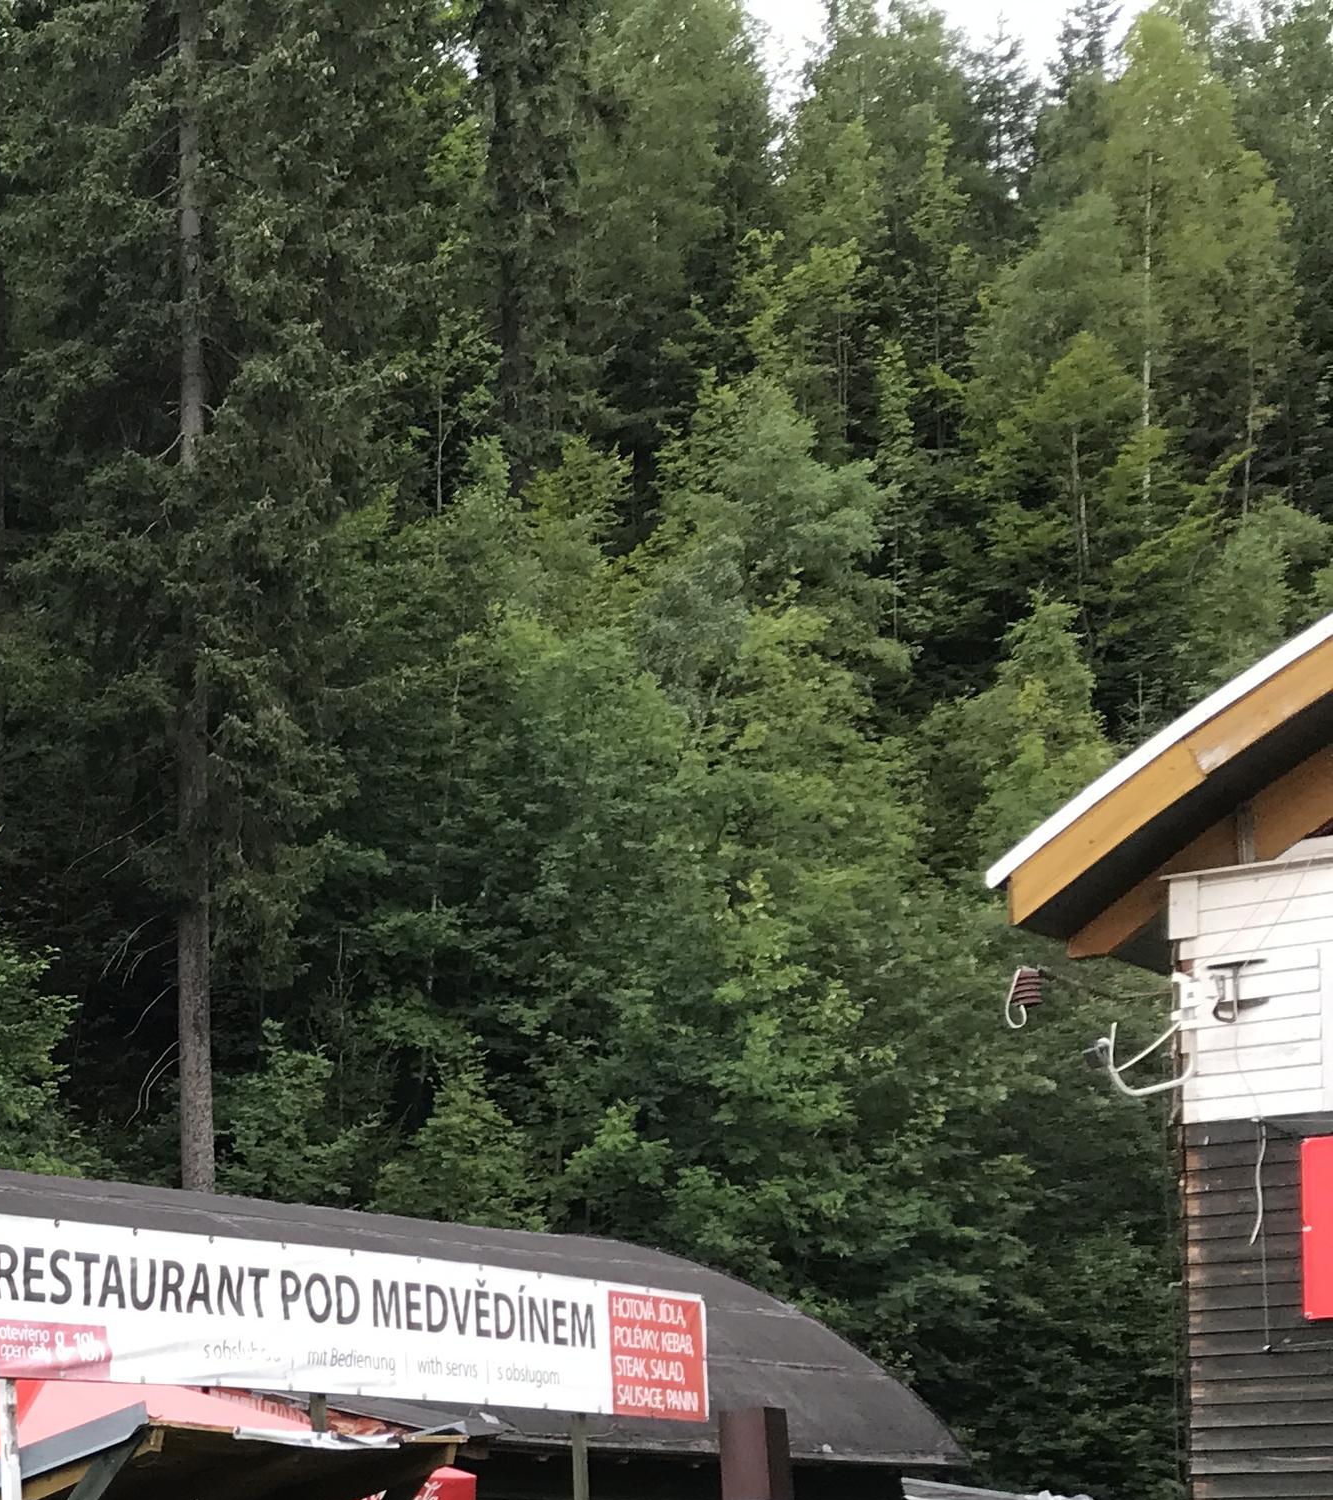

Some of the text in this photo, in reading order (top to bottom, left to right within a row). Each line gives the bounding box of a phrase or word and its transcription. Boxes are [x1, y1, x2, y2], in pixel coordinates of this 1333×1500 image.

[280, 1267, 360, 1325] POD
[372, 1277, 597, 1349] MEDVĚDÍNEM
[612, 1295, 687, 1328] HOTOVÁ JÍDLA,
[0, 1344, 27, 1362] open
[614, 1324, 694, 1357] POLÉVKY, KEBAB,
[329, 1347, 396, 1376] Bedienung
[417, 1356, 443, 1375] with
[445, 1359, 478, 1379] servis
[497, 1366, 504, 1381] s
[615, 1354, 686, 1385] STEAK, SALAD,
[617, 1384, 699, 1413] SAUSAGE, PANINI
